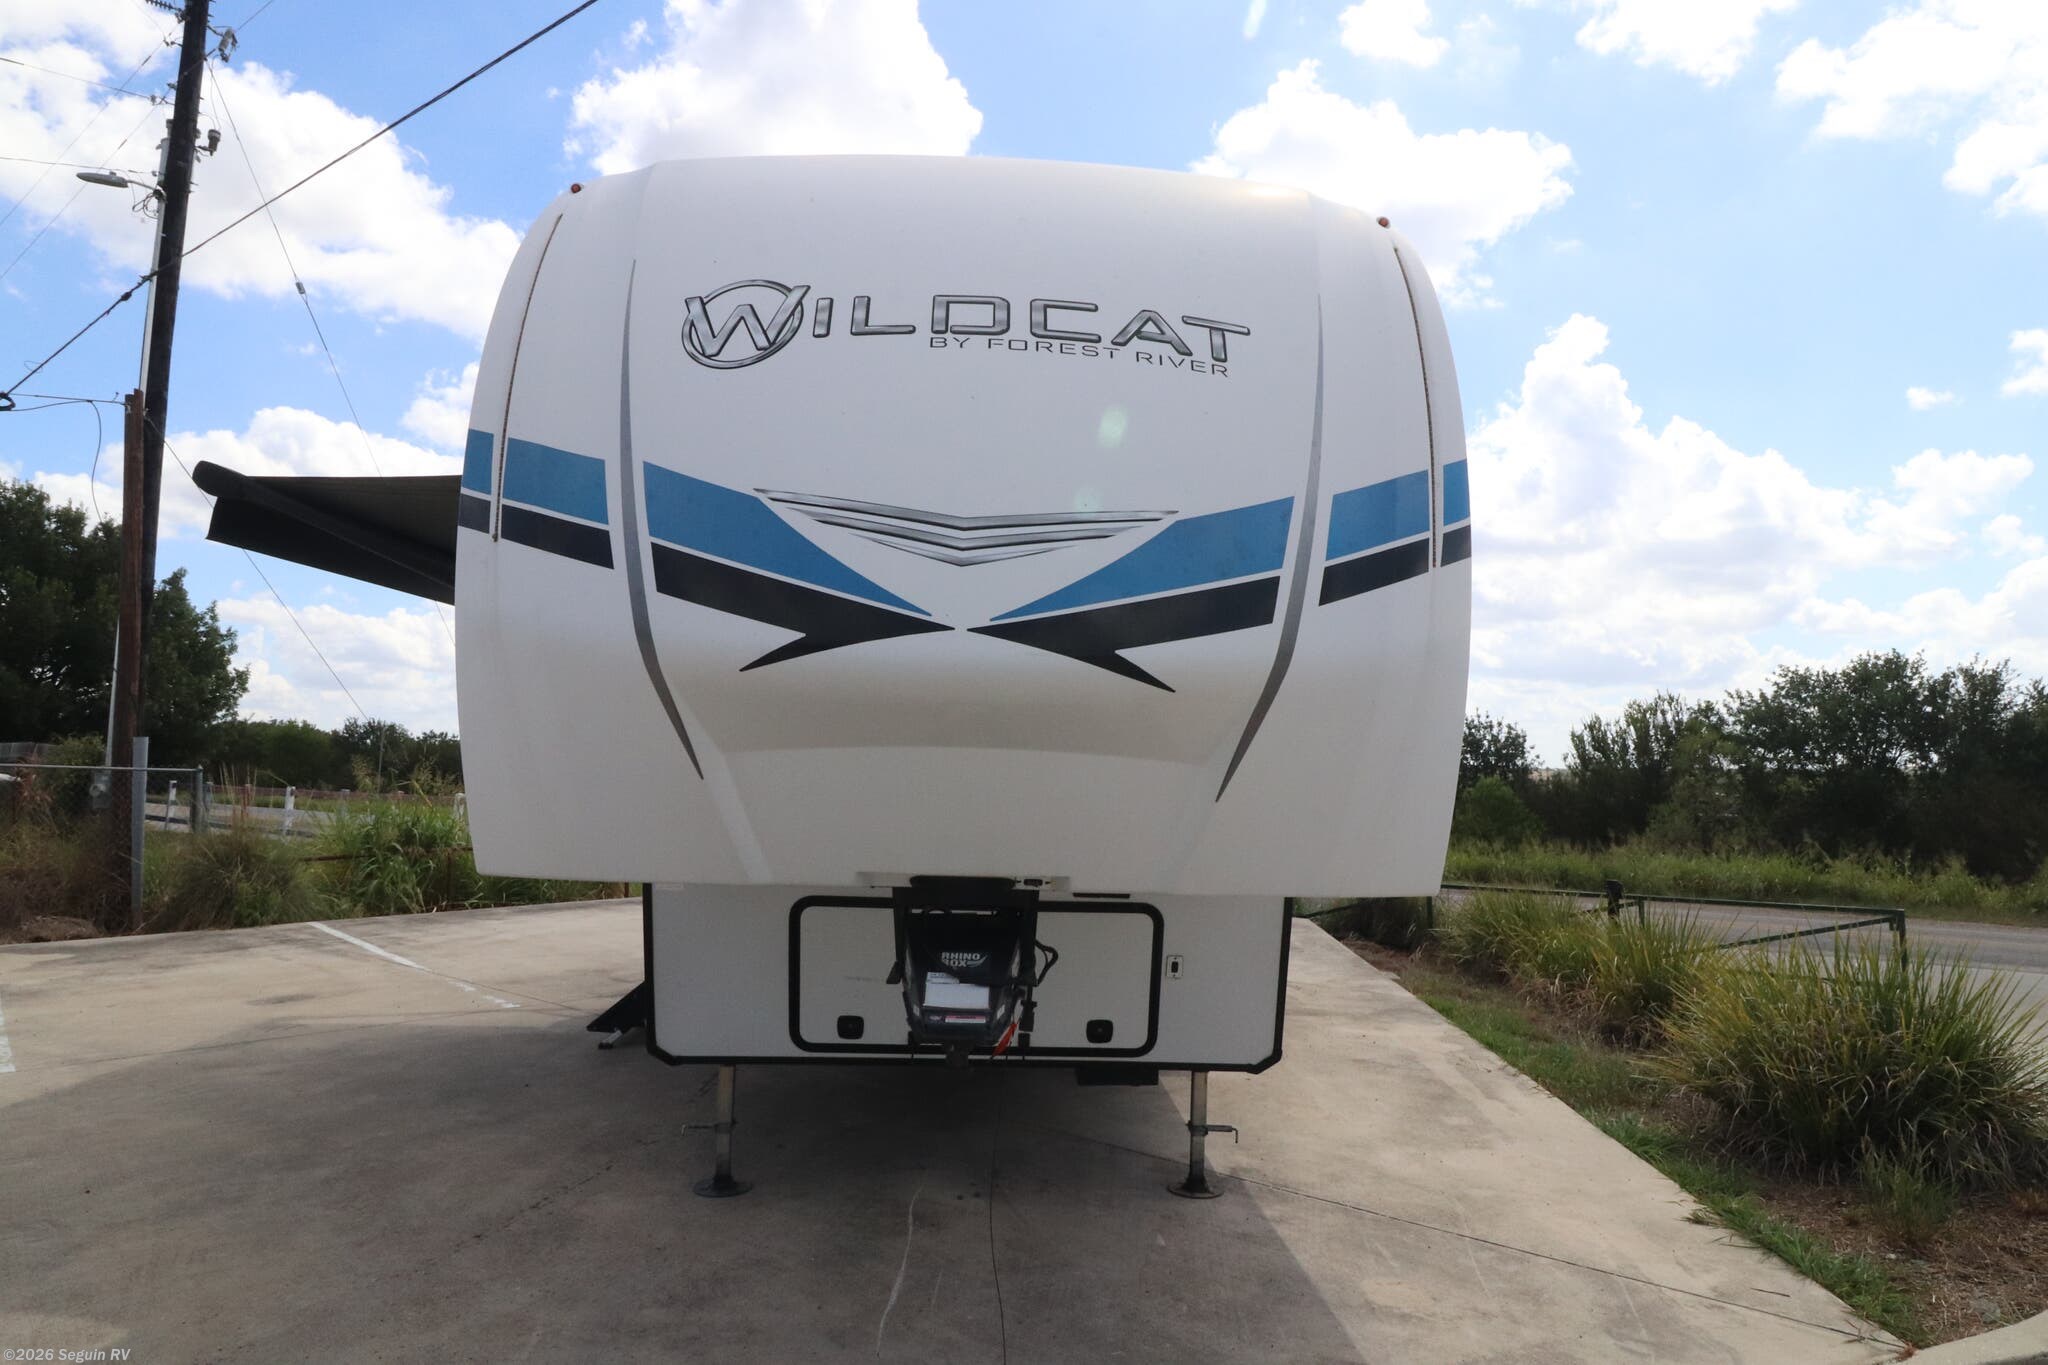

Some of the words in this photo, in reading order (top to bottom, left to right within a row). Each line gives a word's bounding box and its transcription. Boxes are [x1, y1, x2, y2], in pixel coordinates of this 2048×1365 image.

[682, 280, 1250, 368] WILDCAT
[930, 336, 970, 349] BY
[987, 338, 1121, 359] FOREST
[1136, 351, 1230, 377] RIVER
[941, 952, 981, 961] RHINO
